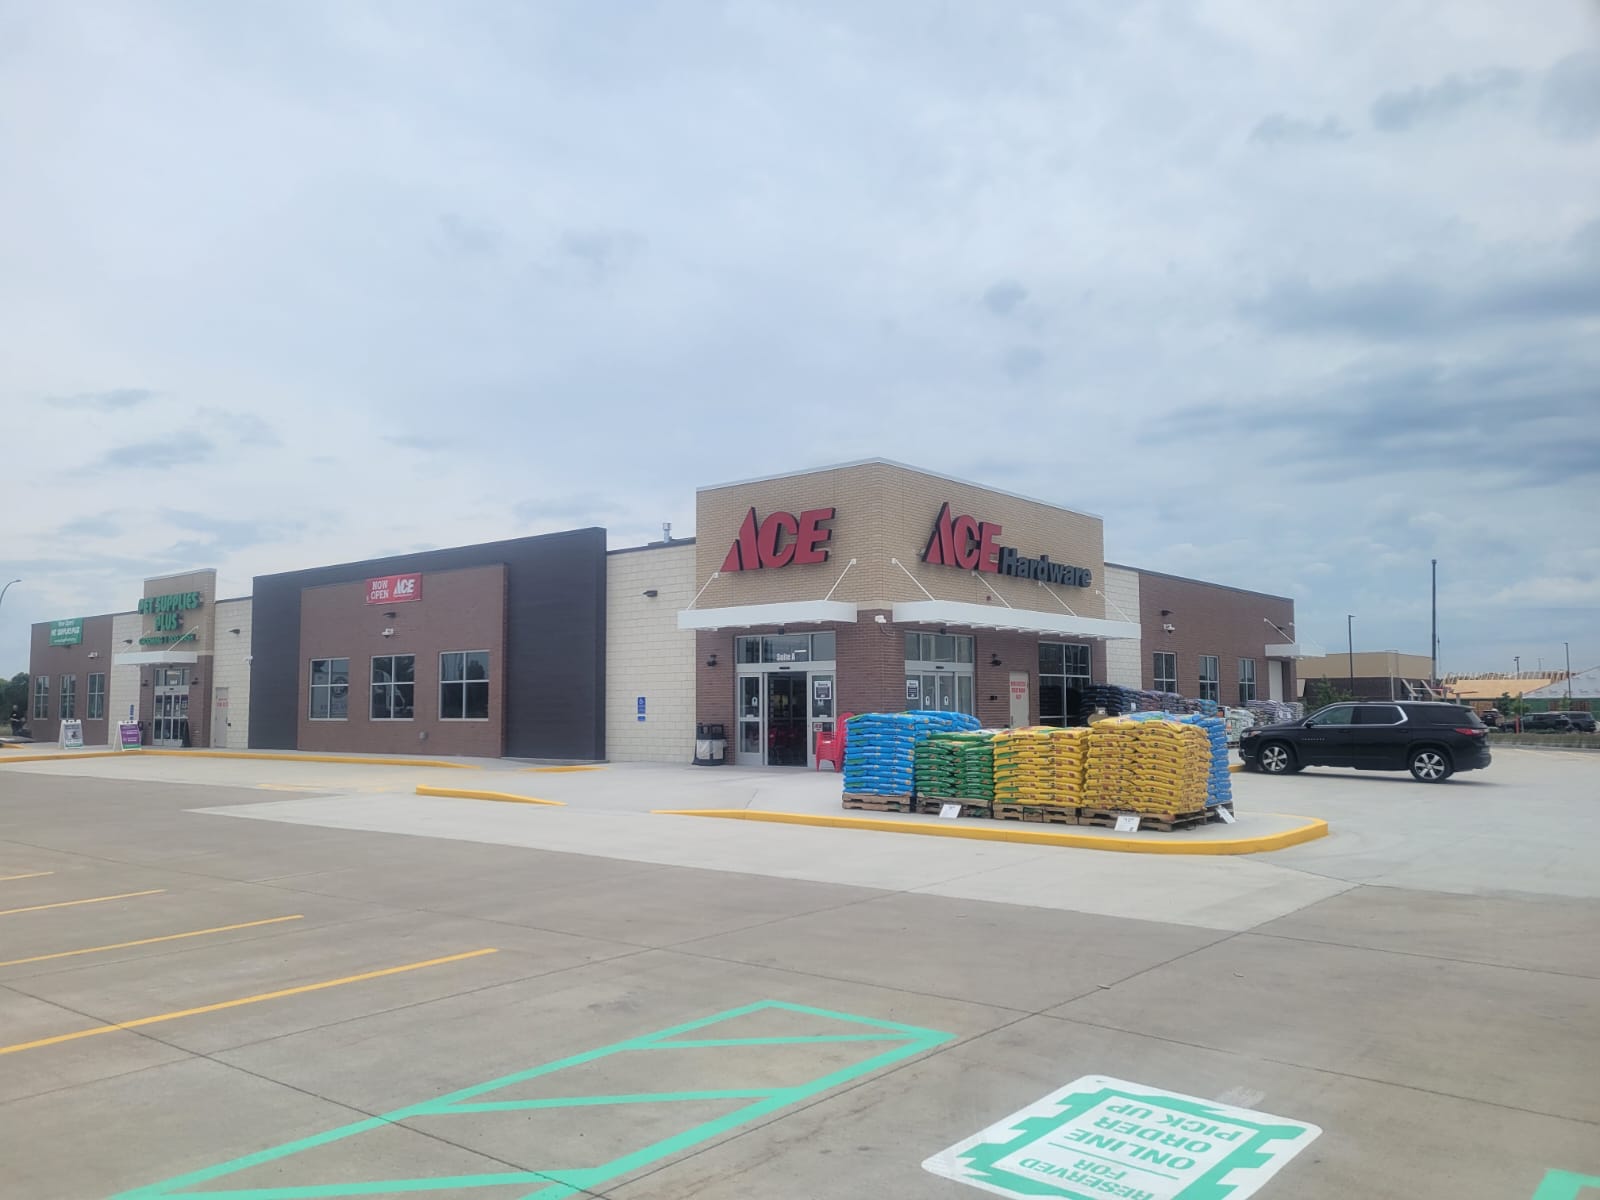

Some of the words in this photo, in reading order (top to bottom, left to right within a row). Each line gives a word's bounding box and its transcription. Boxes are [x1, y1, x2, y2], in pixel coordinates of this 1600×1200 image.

[720, 506, 836, 572] ACE
[922, 502, 1002, 573] ACE
[1000, 548, 1092, 589] Hardware
[371, 590, 389, 600] OPEN
[372, 580, 388, 590] NOW
[393, 578, 415, 594] ACE
[138, 599, 153, 614] PET
[155, 592, 199, 612] SUPPLIES
[155, 613, 178, 631] PLUS
[1106, 1104, 1153, 1121] UP
[1094, 1115, 1213, 1154] ORDER
[1159, 1111, 1242, 1143] PICK
[1064, 1128, 1197, 1171] ONLINE
[1018, 1157, 1155, 1200] RESERVED
[1073, 1159, 1128, 1180] FOR
